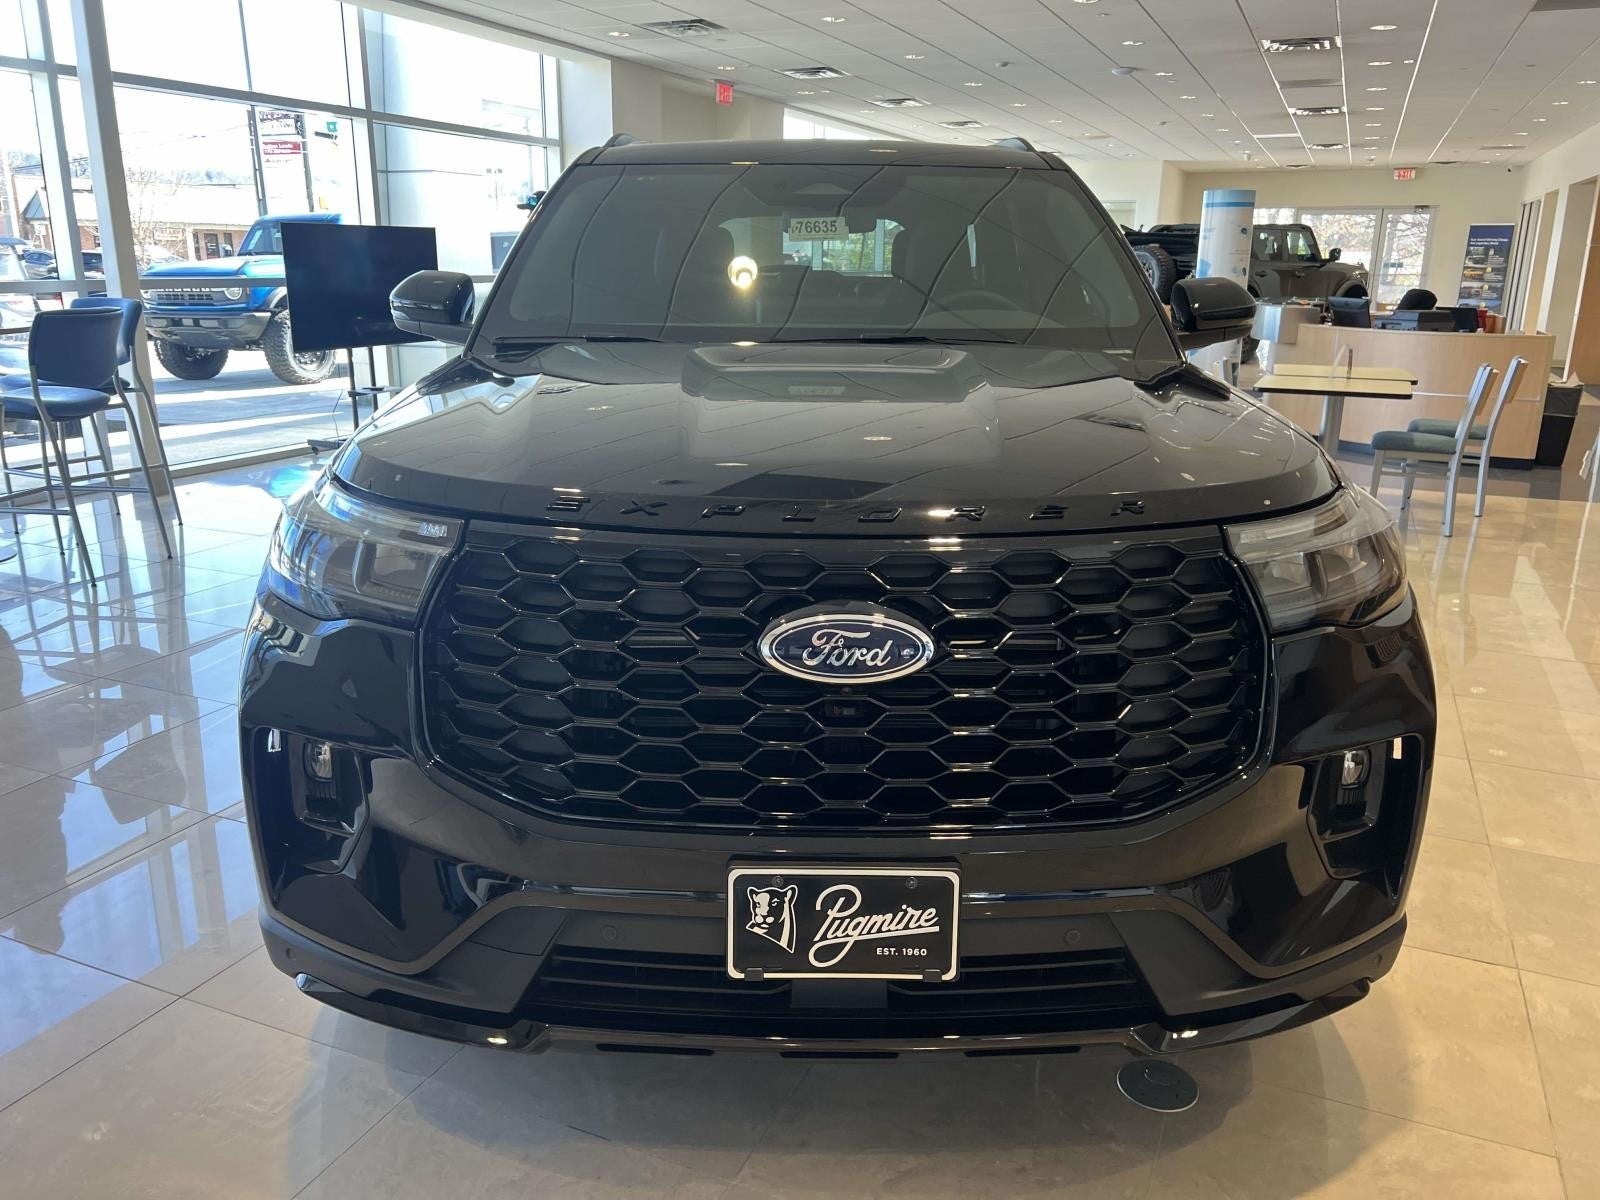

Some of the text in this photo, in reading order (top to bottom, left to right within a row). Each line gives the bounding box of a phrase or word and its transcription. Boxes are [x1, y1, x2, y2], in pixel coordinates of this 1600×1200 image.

[545, 492, 1145, 523] EXPLORER
[802, 628, 894, 667] Ford
[808, 884, 940, 968] Pugmire
[876, 947, 928, 956] EST. 1960
